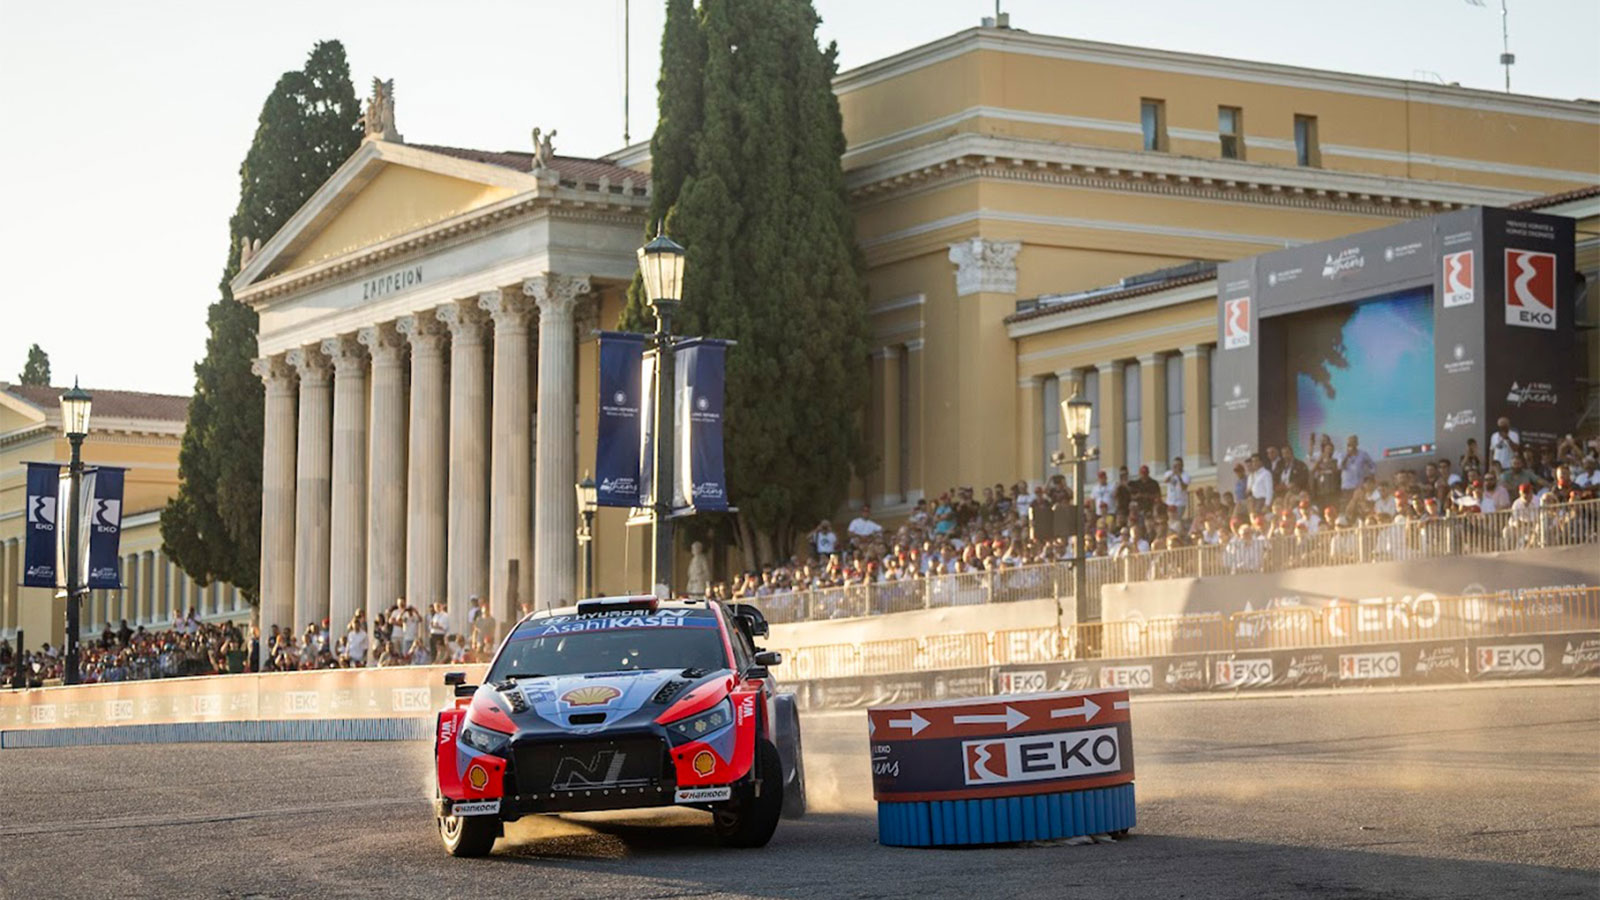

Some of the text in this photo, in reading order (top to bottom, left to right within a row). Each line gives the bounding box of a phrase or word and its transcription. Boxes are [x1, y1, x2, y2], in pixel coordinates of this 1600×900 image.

[1452, 292, 1471, 302] EKO
[1520, 310, 1552, 325] EKO
[35, 523, 54, 531] EKO
[575, 609, 649, 621] HYUNDAI
[1358, 592, 1440, 632] EKO
[1358, 656, 1399, 674] EKO
[1497, 648, 1543, 667] EKO
[1117, 669, 1150, 685] EKO
[1234, 662, 1271, 680] EKO
[1014, 674, 1046, 690] EKO
[1020, 734, 1117, 773] EKO
